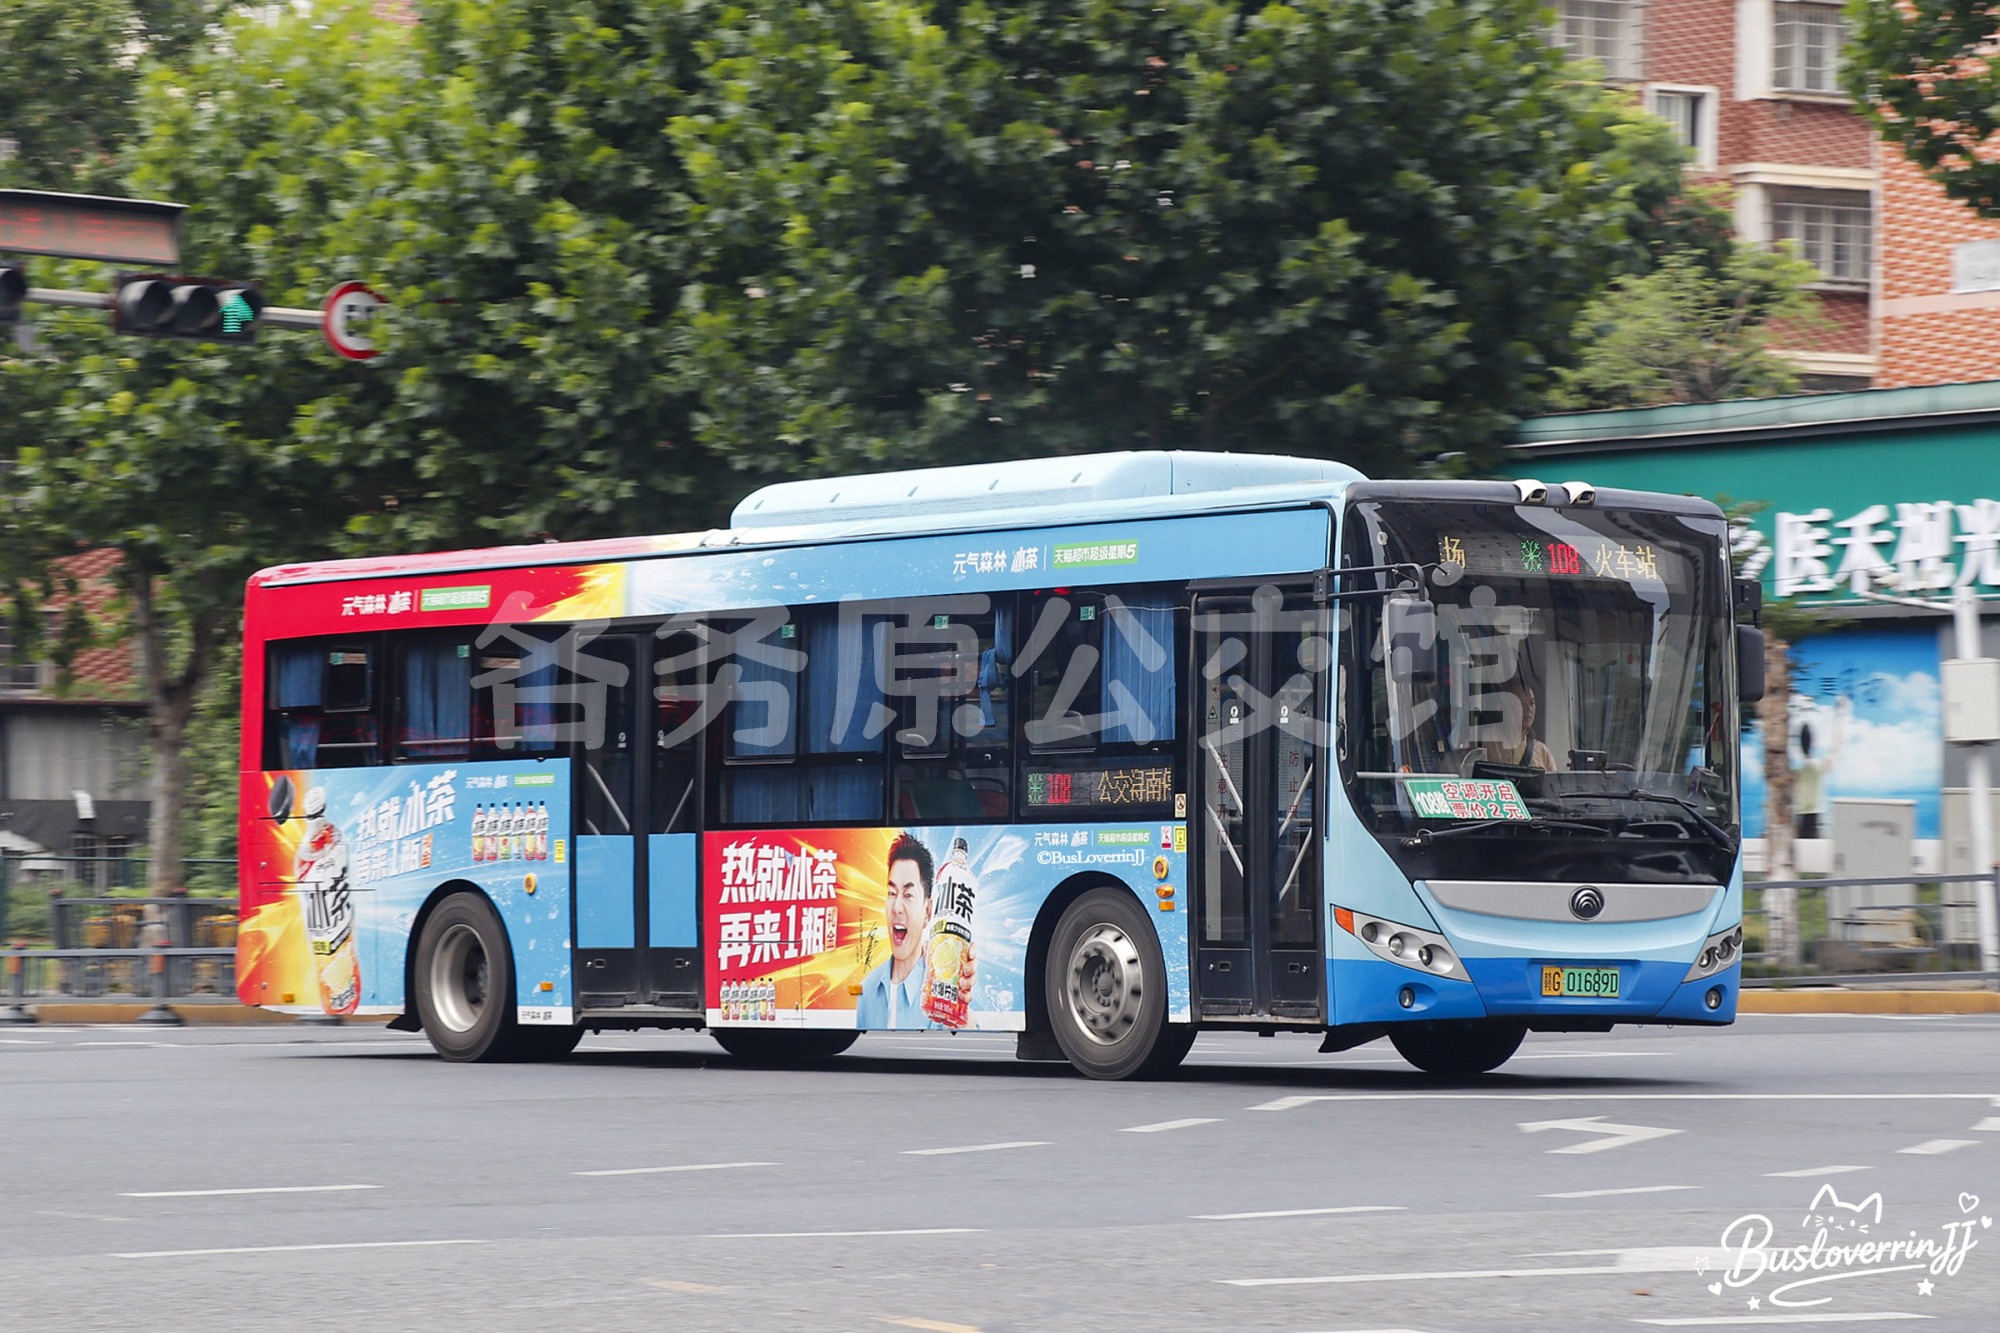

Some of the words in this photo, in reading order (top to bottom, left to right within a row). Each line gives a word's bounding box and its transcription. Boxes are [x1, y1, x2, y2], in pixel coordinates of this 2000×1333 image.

[953, 550, 1007, 575] 元气森林
[1547, 543, 1580, 574] 108
[1595, 543, 1658, 579] 火车站
[1047, 773, 1072, 804] 108
[1441, 782, 1517, 801] 空调开启
[1449, 801, 1525, 819] 票价2元
[719, 836, 838, 904] 热就冰茶
[717, 904, 826, 971] 再来1瓶
